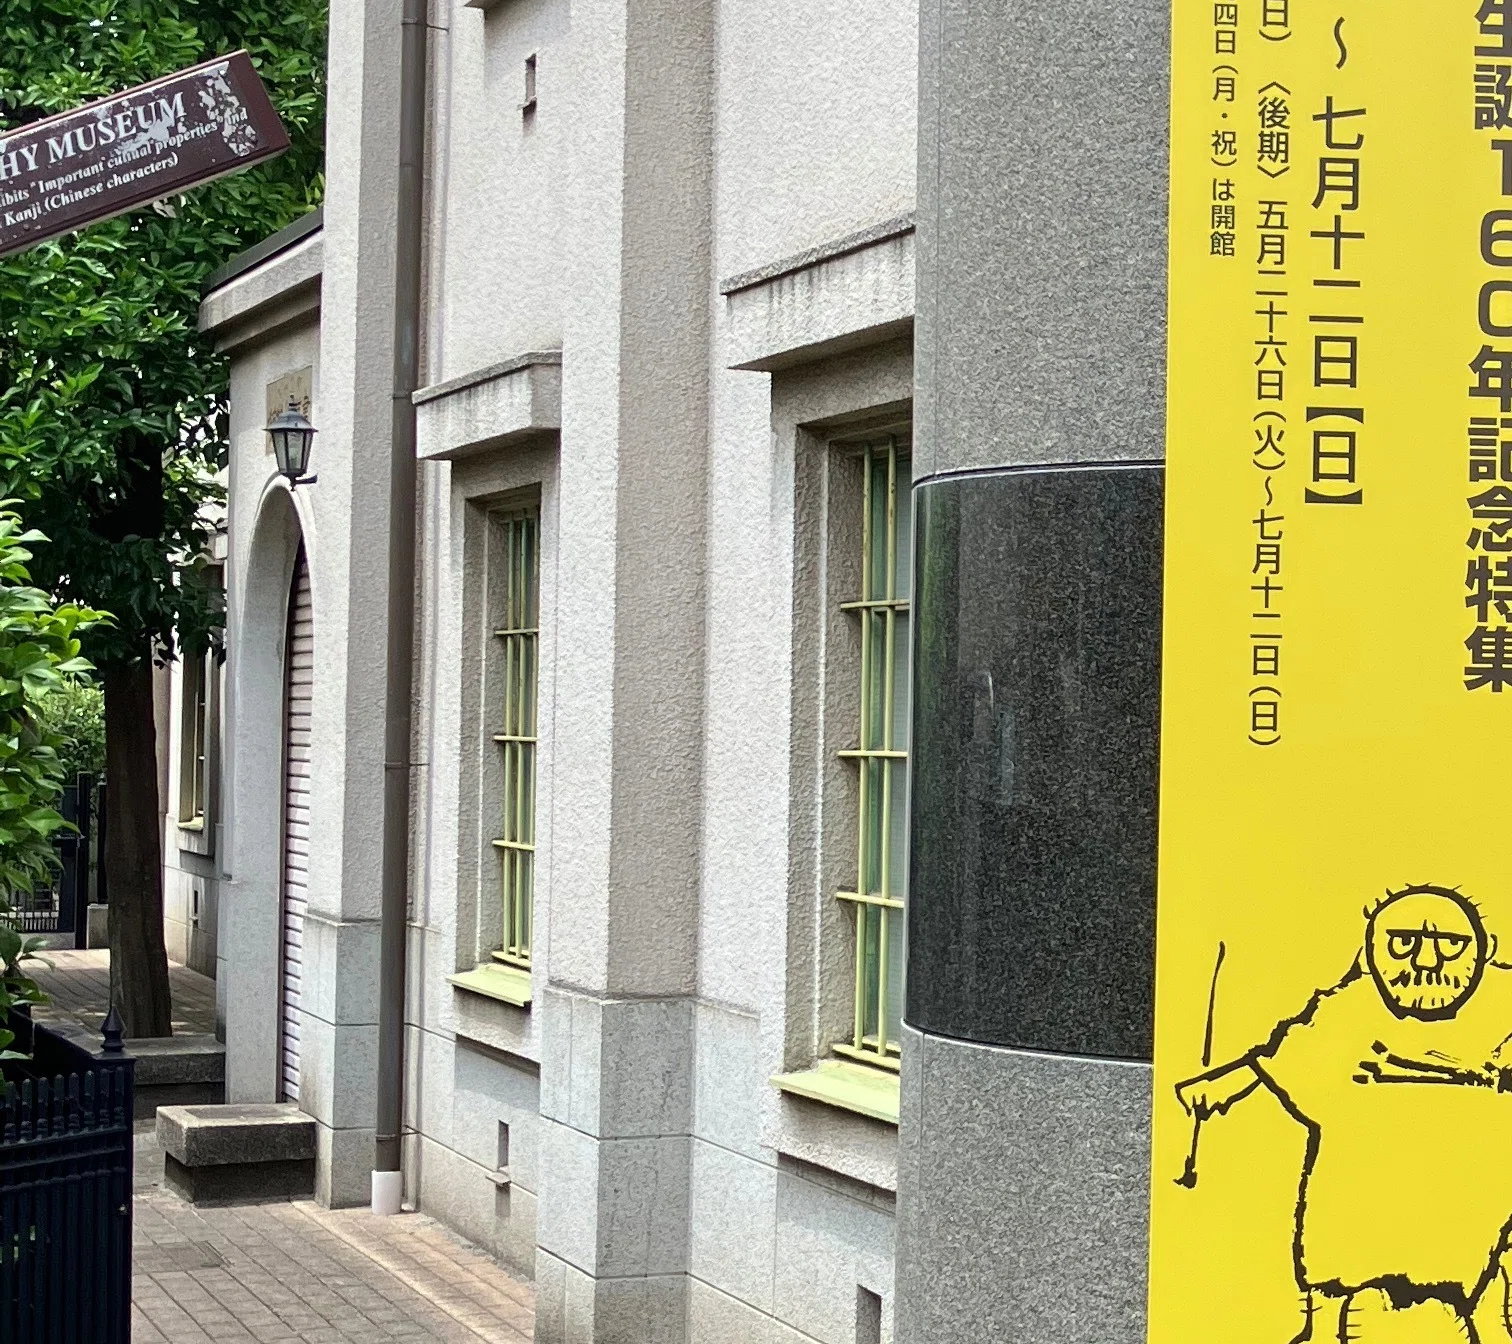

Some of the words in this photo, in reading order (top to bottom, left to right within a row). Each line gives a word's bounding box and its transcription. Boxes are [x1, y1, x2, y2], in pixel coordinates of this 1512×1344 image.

[45, 91, 187, 164] MUSEUM
[5, 201, 43, 227] Kanji
[44, 182, 104, 212] (Chinese
[106, 151, 179, 190] characters)
